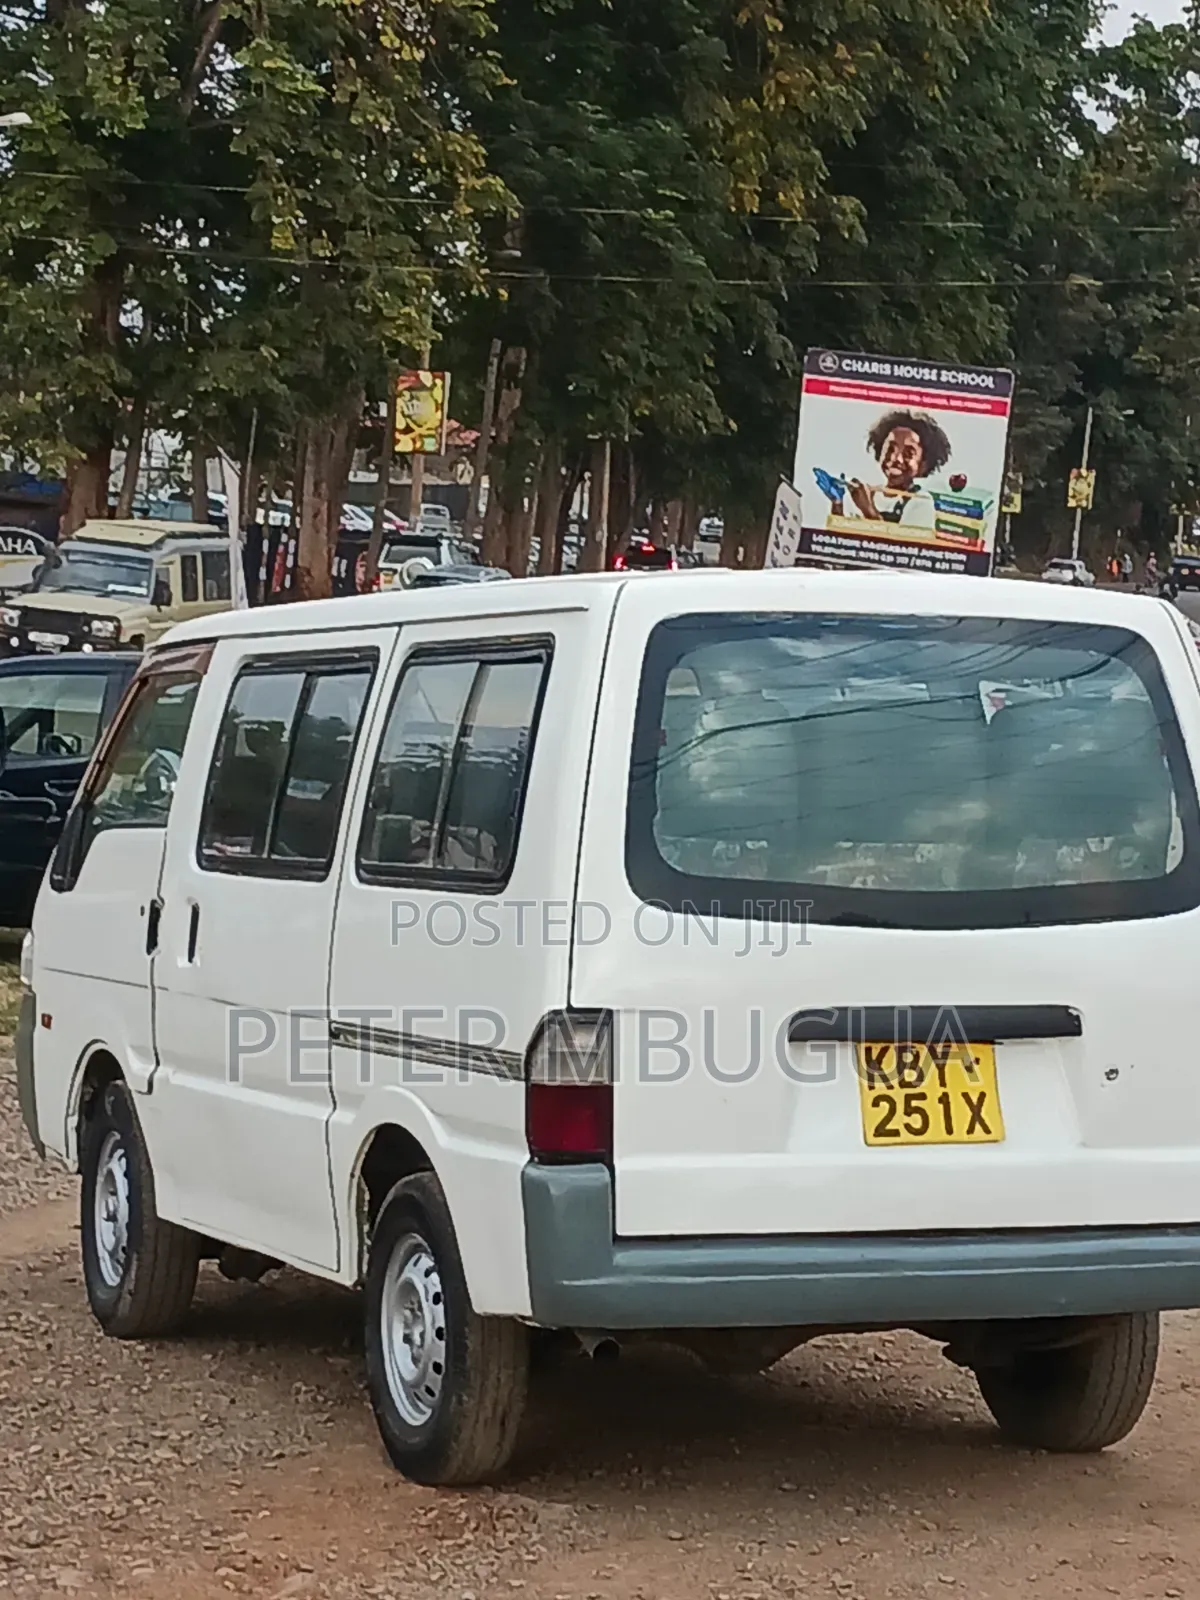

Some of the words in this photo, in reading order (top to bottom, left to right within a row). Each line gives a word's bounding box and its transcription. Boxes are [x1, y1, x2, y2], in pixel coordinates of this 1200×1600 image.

[842, 359, 891, 375] CHARIS
[893, 364, 938, 380] HOUSE
[940, 372, 995, 388] SCHOOL
[865, 1045, 952, 1091] KBY
[871, 1091, 992, 1138] 251X
